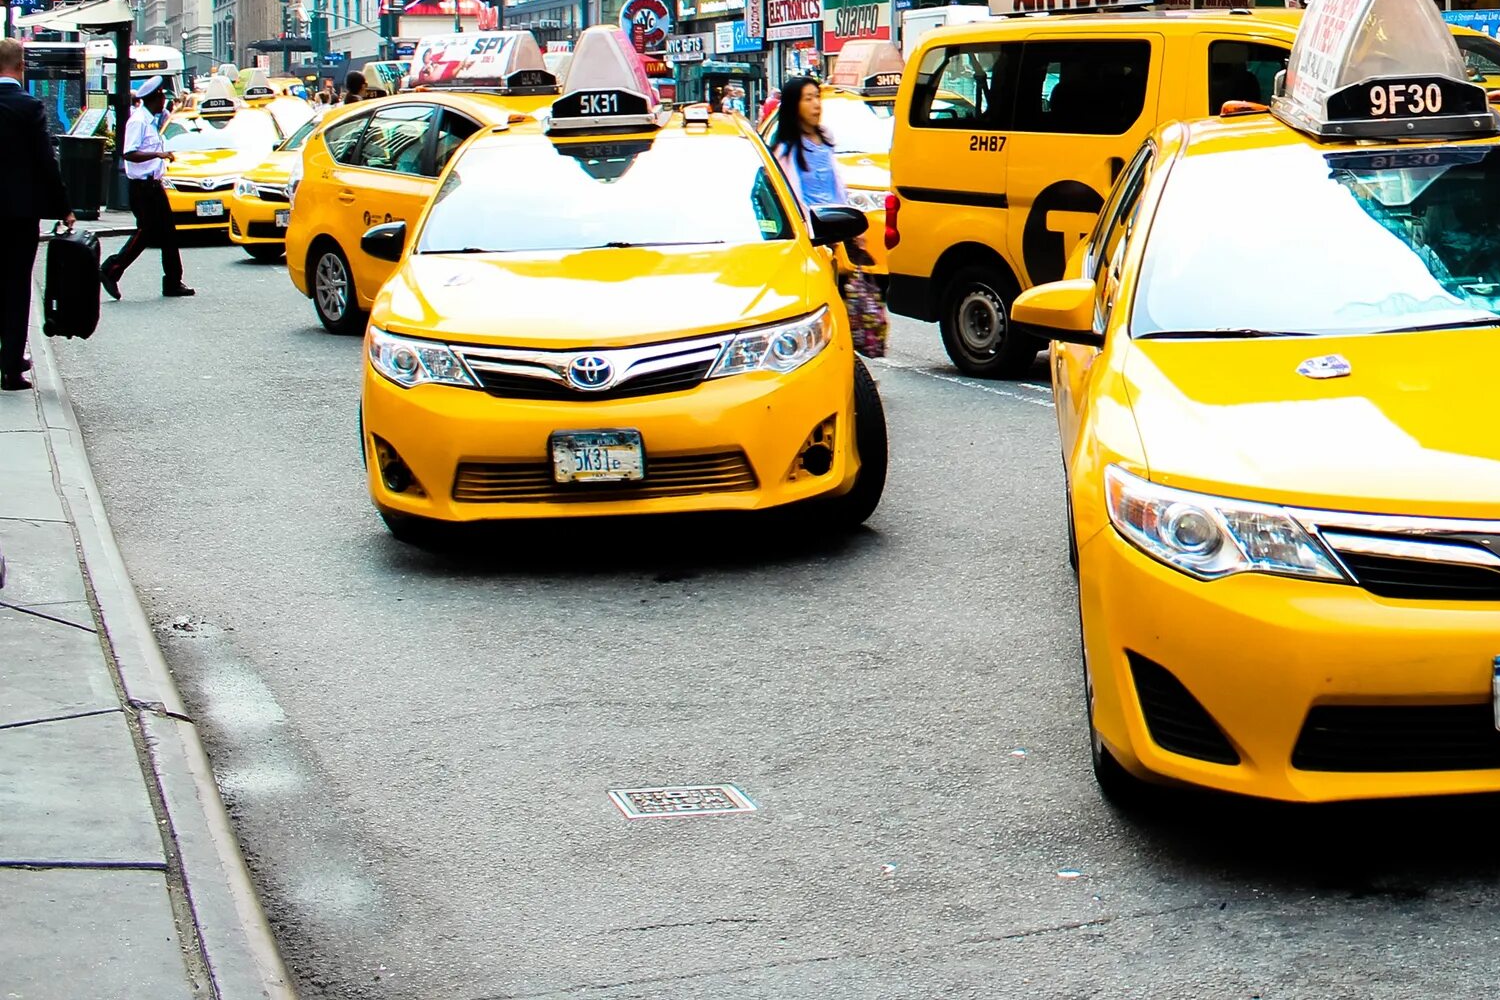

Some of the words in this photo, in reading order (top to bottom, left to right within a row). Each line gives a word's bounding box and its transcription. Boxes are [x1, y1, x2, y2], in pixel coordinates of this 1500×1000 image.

[835, 0, 879, 38] sbarro
[470, 37, 515, 55] SPY
[667, 39, 681, 52] NYC
[682, 36, 701, 51] GIFTS
[877, 74, 901, 86] 3H76
[580, 93, 619, 114] 5K31
[1369, 83, 1443, 116] 9F30
[969, 135, 1007, 152] 2H87
